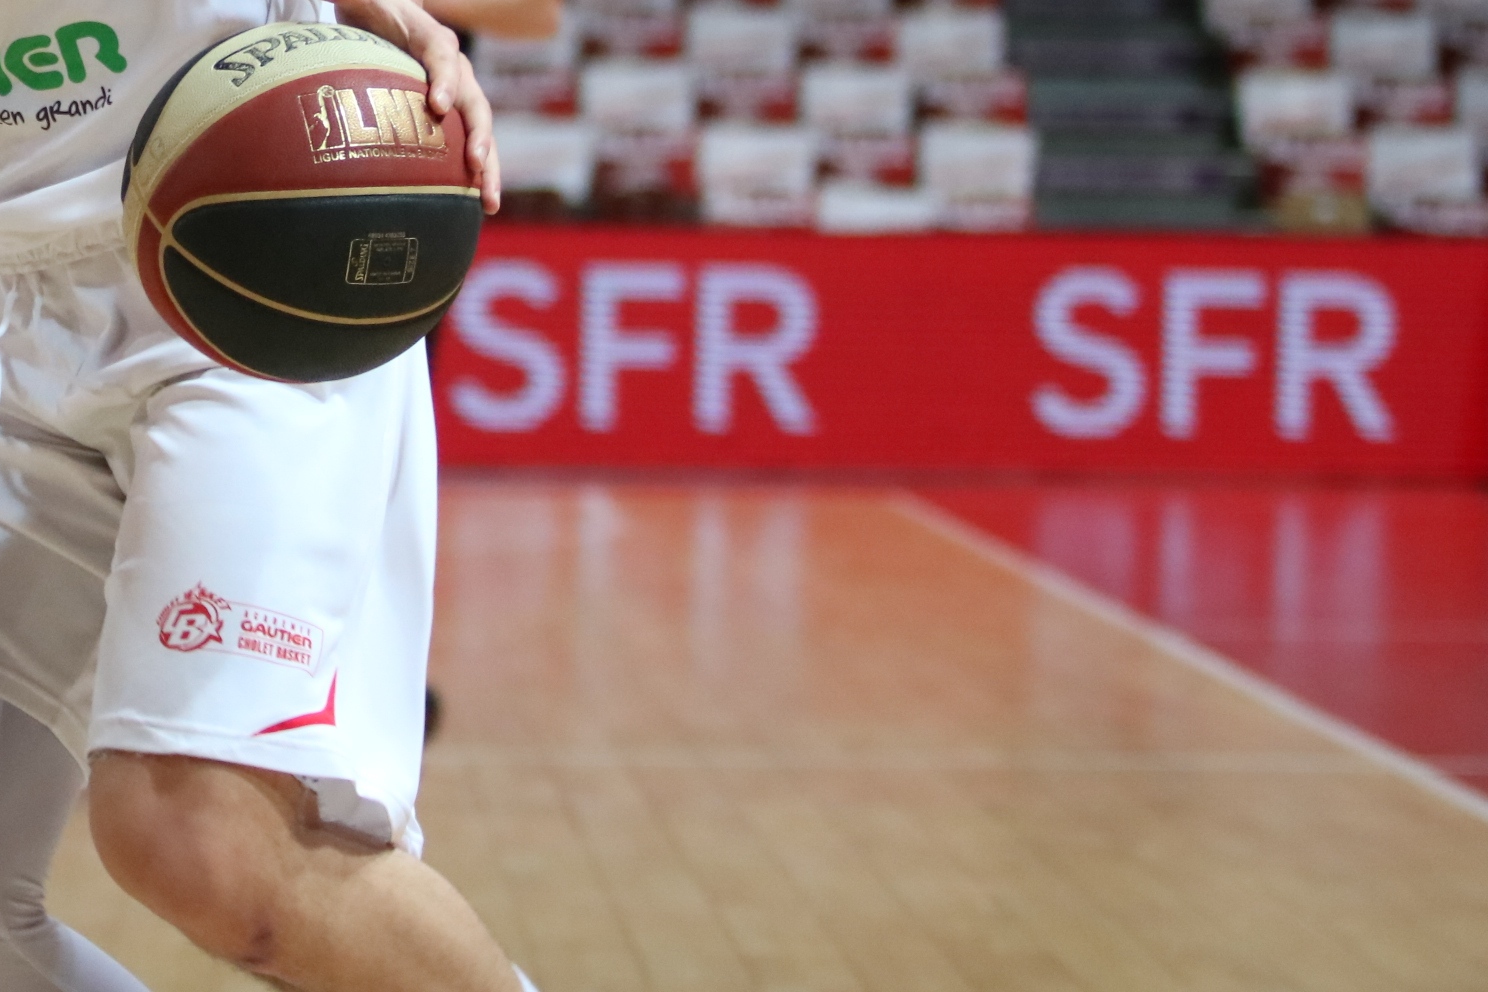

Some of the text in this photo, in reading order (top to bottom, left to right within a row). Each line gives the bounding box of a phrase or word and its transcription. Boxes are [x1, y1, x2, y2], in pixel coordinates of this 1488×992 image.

[313, 150, 346, 164] LIGUE
[348, 147, 406, 159] NATIONALE
[446, 258, 820, 436] SFR
[1029, 265, 1396, 443] SFR
[241, 619, 312, 649] GAUTIER
[237, 635, 311, 666] CHOLET BASKET
